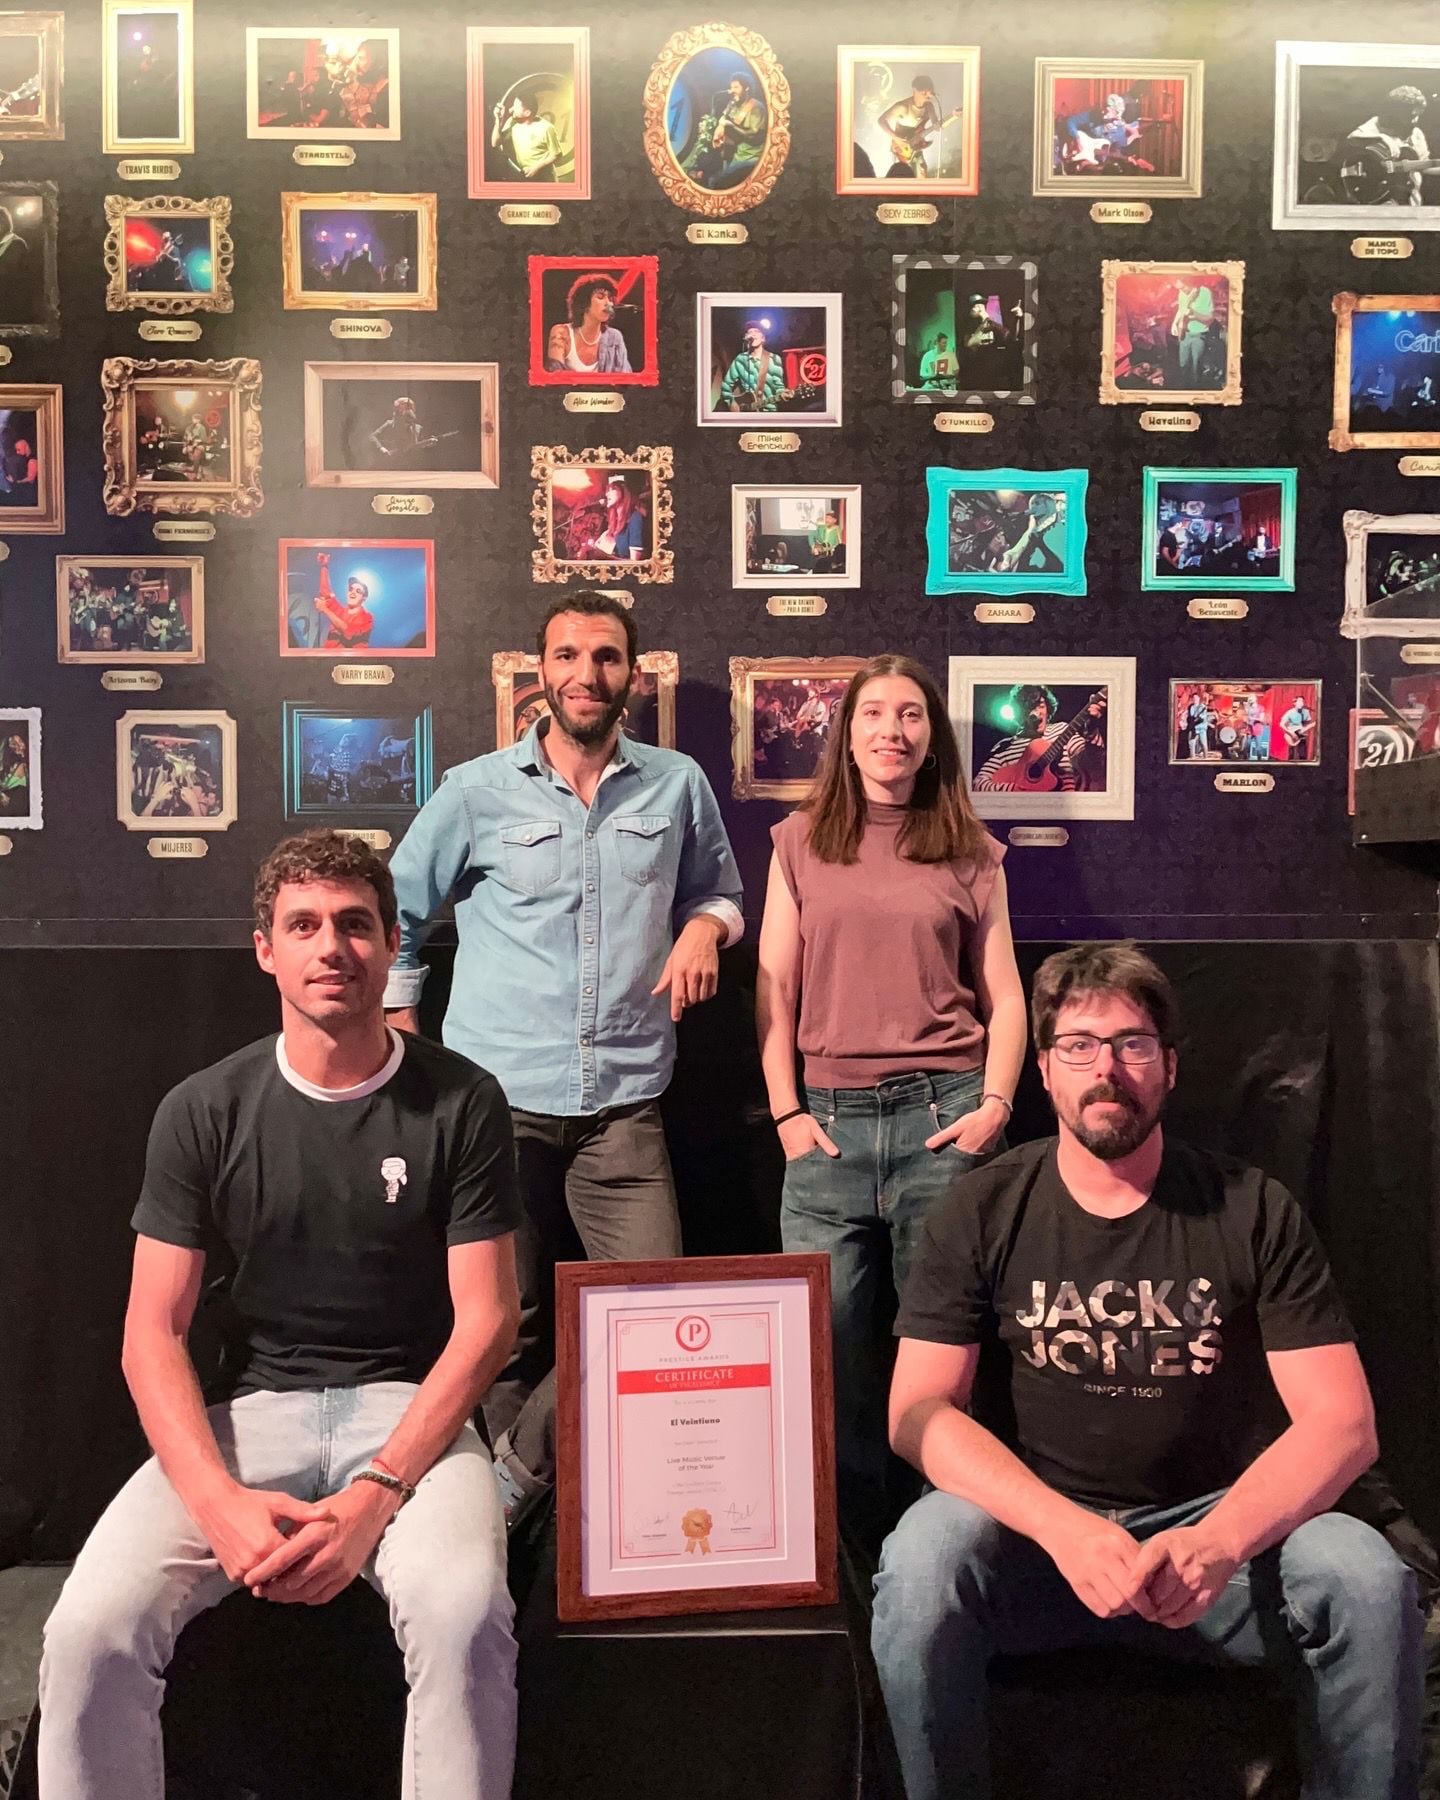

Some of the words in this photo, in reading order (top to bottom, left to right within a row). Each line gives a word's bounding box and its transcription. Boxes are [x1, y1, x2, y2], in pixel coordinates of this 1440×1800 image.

[125, 165, 150, 174] TRAVIS
[152, 165, 173, 174] BIRDS
[884, 208, 901, 219] SEXY
[903, 208, 931, 219] ZEBRAS
[1098, 207, 1120, 217] Mark
[1123, 207, 1145, 217] Olson
[696, 229, 704, 238] El
[707, 229, 738, 239] Kanka
[1367, 240, 1397, 248] MANOS
[757, 433, 782, 442] Mikel
[747, 441, 793, 450] Erentxun
[987, 609, 1022, 617] ZAHARA
[341, 669, 362, 680] VARRY
[364, 669, 385, 680] BRAVA
[161, 843, 193, 853] MUJERES
[1020, 1329, 1223, 1377] JONES
[655, 1368, 734, 1383] CERTIFICATE
[1083, 1384, 1127, 1397] SINCE
[670, 1418, 679, 1427] El
[680, 1417, 721, 1426] Veintiuno
